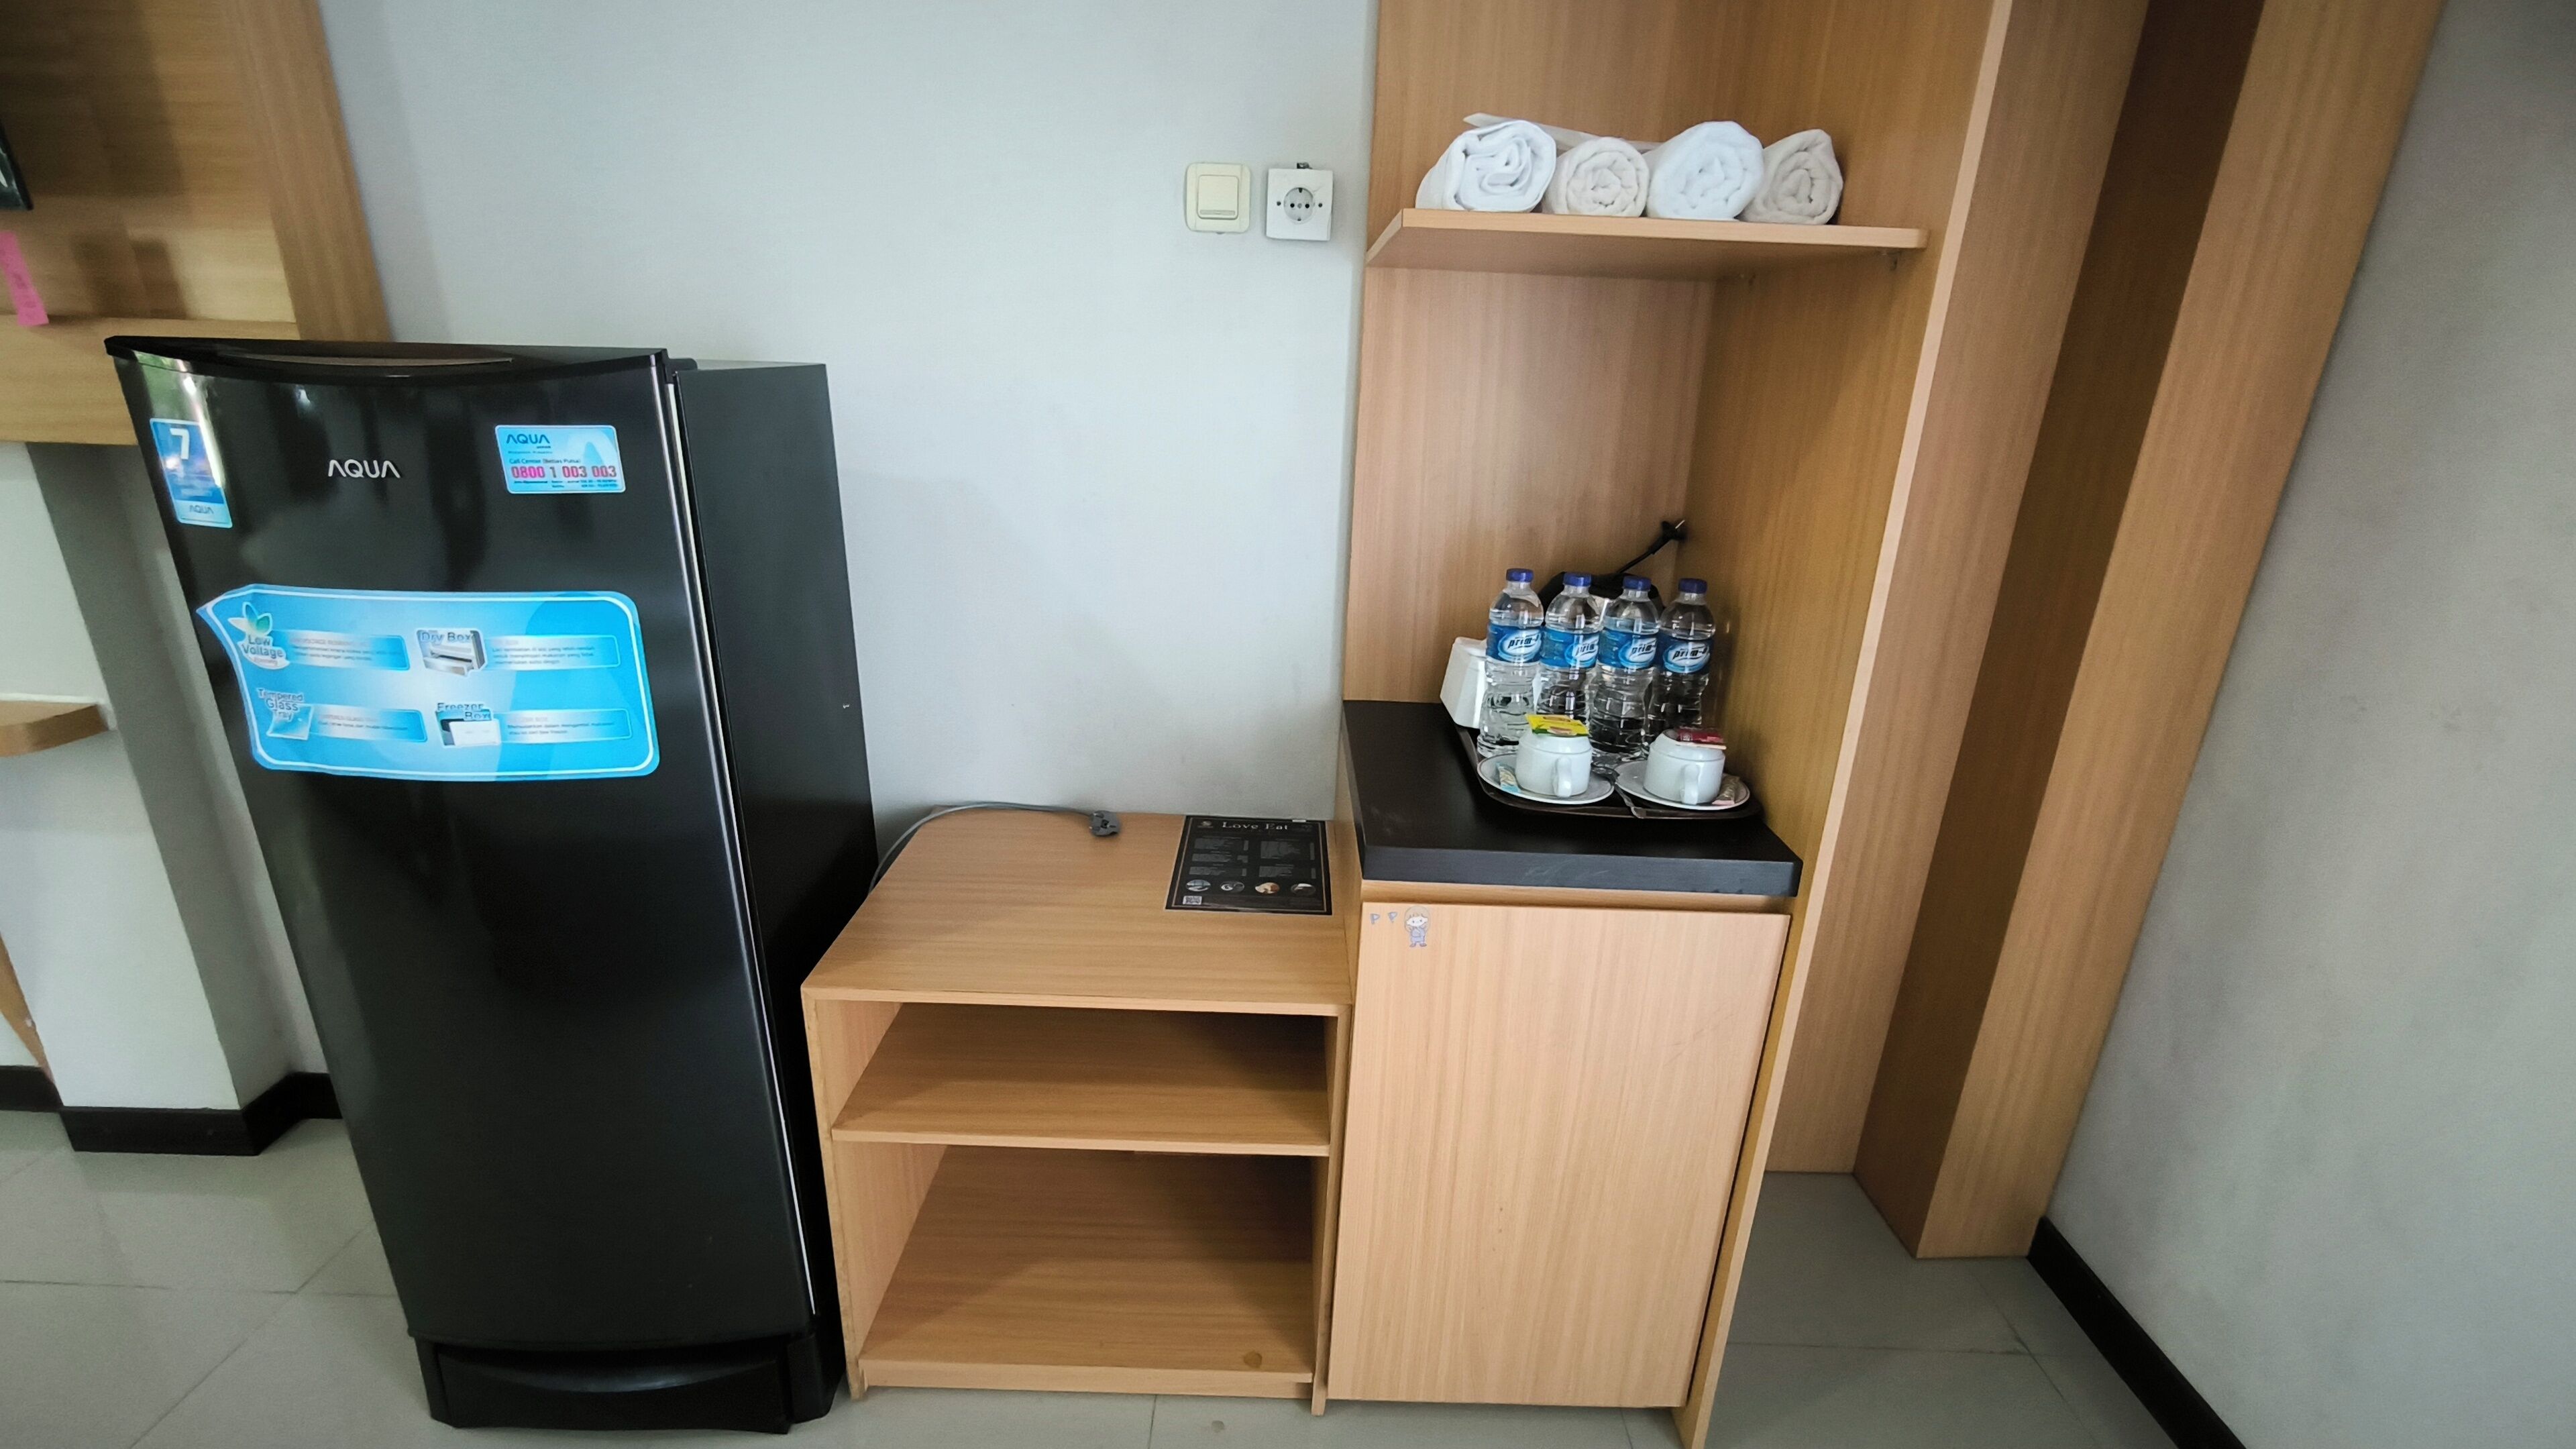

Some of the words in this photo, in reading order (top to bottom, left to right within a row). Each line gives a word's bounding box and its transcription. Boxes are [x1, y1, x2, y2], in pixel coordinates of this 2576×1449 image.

[170, 428, 190, 460] 7
[506, 433, 550, 444] AQUA
[328, 459, 400, 478] AQUA
[511, 466, 546, 478] 0800
[550, 466, 557, 478] 1
[562, 466, 588, 478] 003
[592, 466, 617, 478] 003
[248, 635, 270, 646] Low
[420, 631, 443, 645] Dry
[241, 644, 283, 659] Voltage
[266, 698, 299, 712] Glass
[437, 702, 484, 713] Freezer
[1222, 821, 1258, 829] Love
